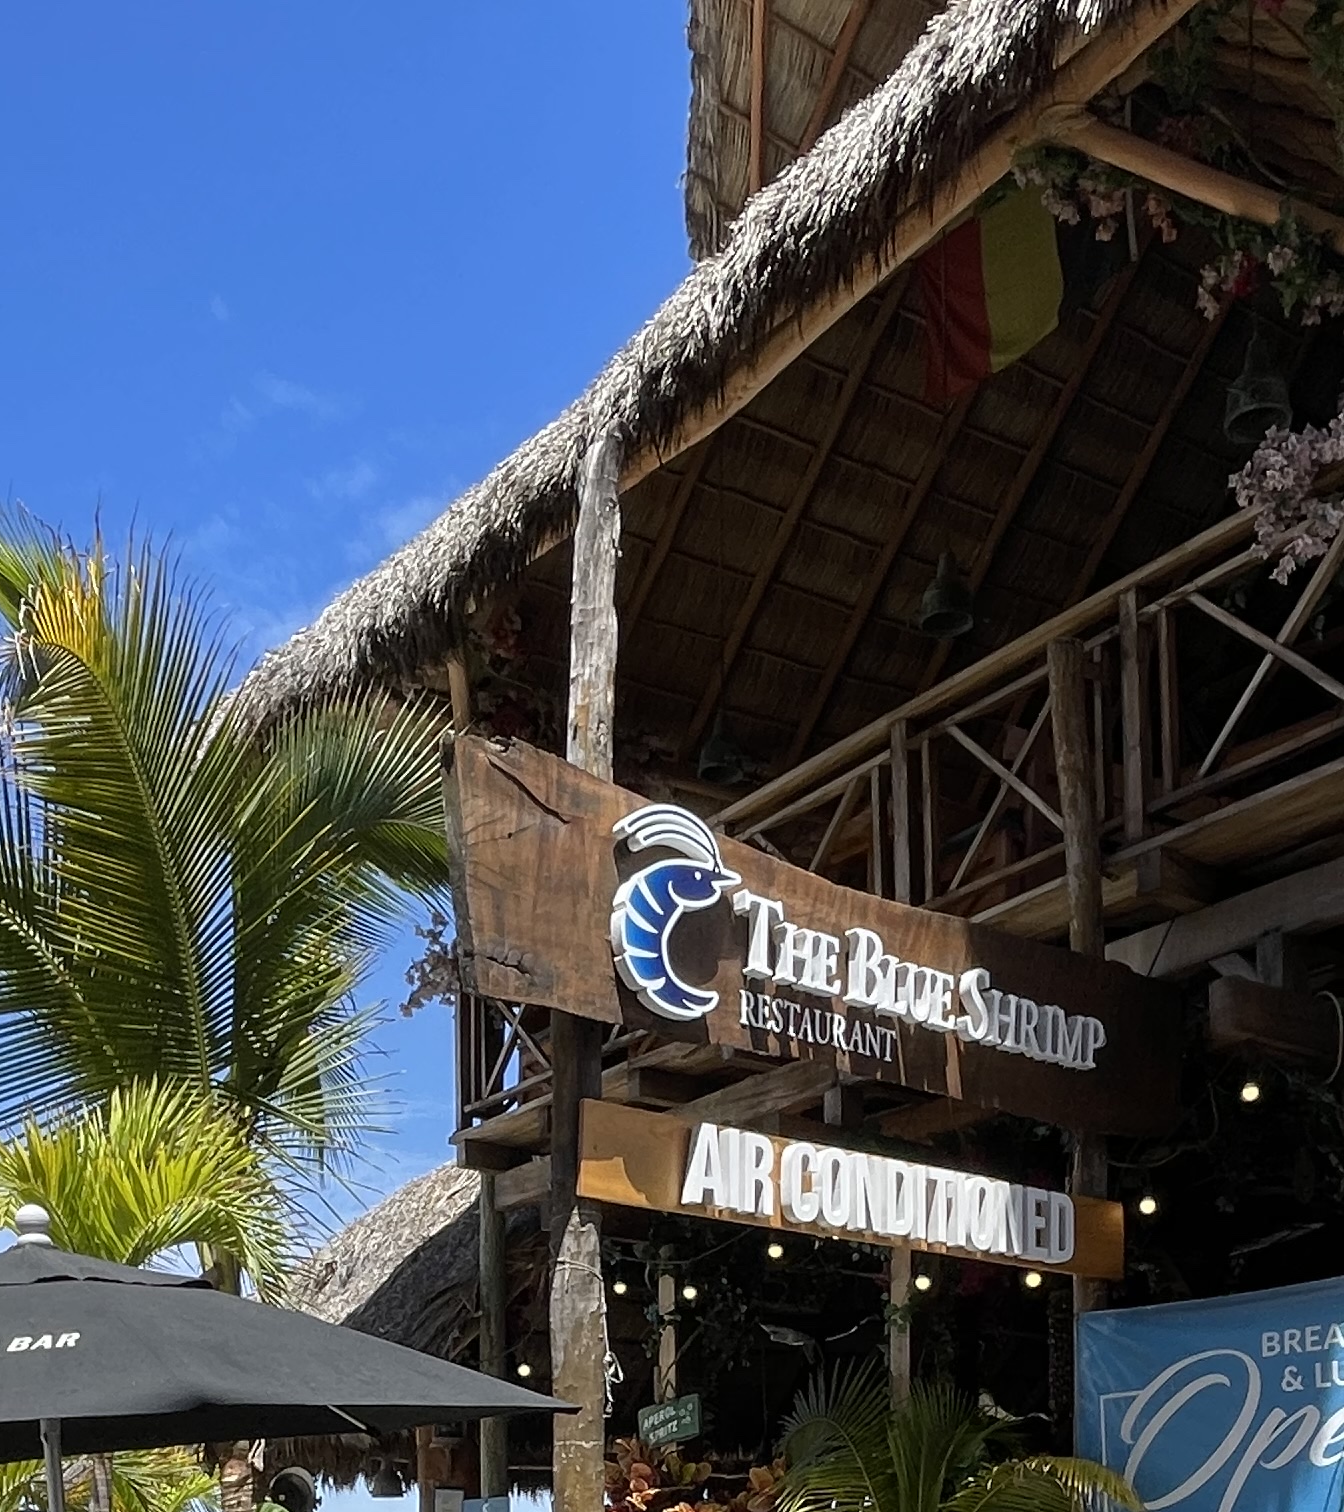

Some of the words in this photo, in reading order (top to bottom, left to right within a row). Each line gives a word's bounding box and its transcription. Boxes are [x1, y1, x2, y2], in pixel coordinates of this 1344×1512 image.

[738, 989, 897, 1062] RESTAURANT
[681, 1122, 775, 1215] AIR
[780, 1141, 1075, 1264] CONDITIONED
[7, 1332, 81, 1352] BAR
[1279, 1366, 1304, 1393] &
